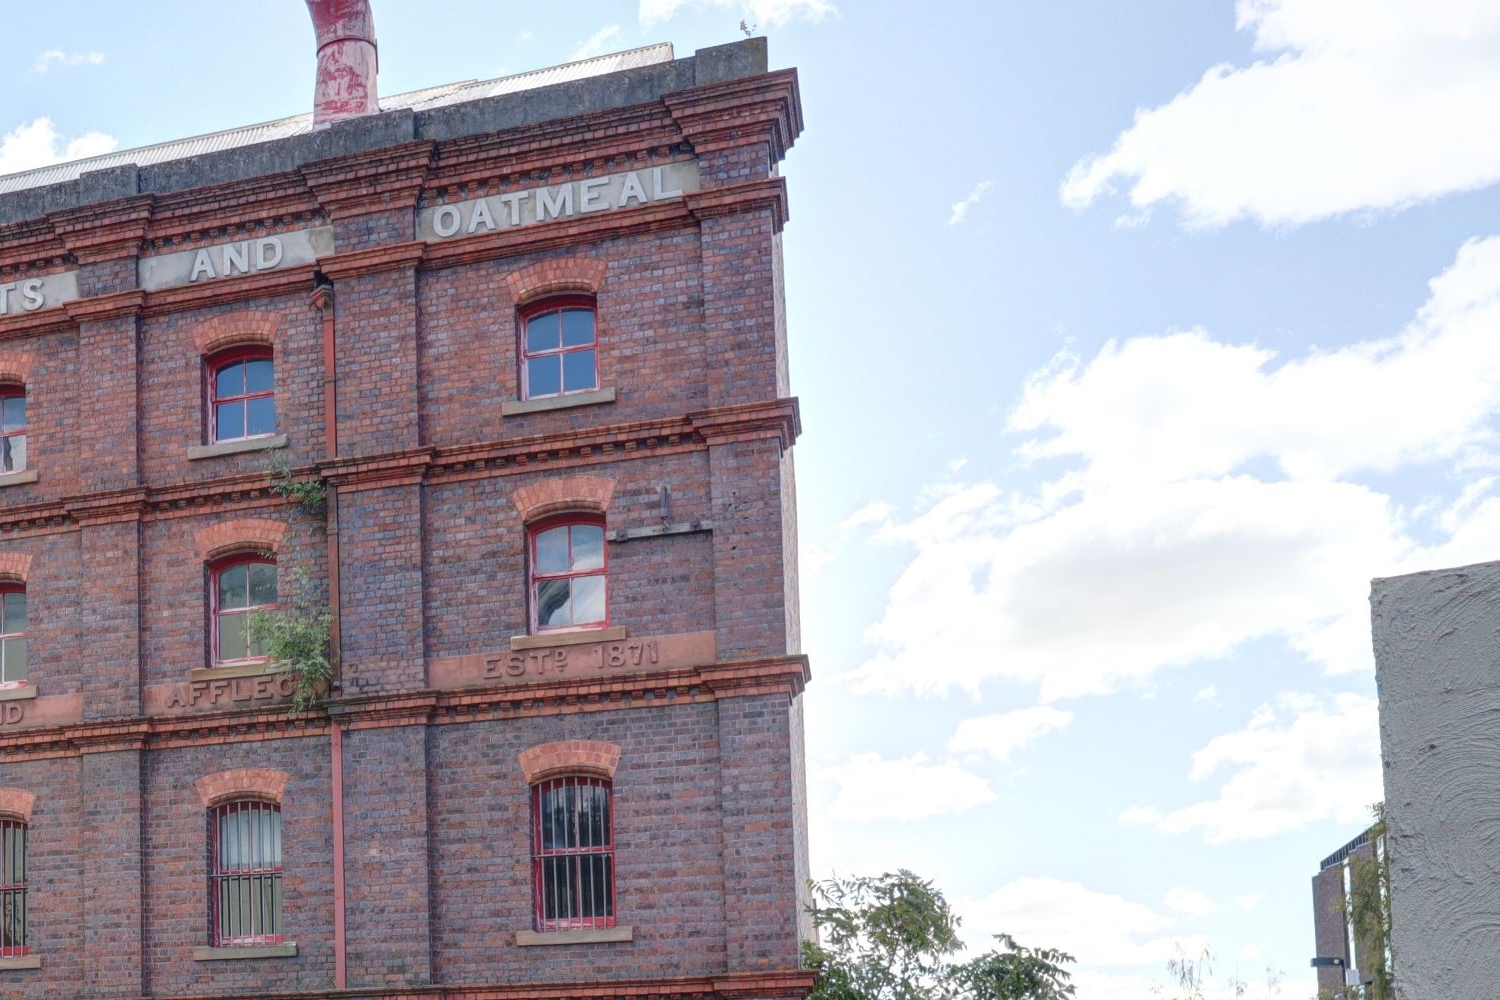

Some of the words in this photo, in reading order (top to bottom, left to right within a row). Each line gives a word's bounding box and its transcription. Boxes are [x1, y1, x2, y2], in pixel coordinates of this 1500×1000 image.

[189, 235, 283, 283] AND
[432, 166, 684, 239] OATMEAL
[594, 639, 659, 669] 1871
[167, 671, 318, 708] AFFLEC
